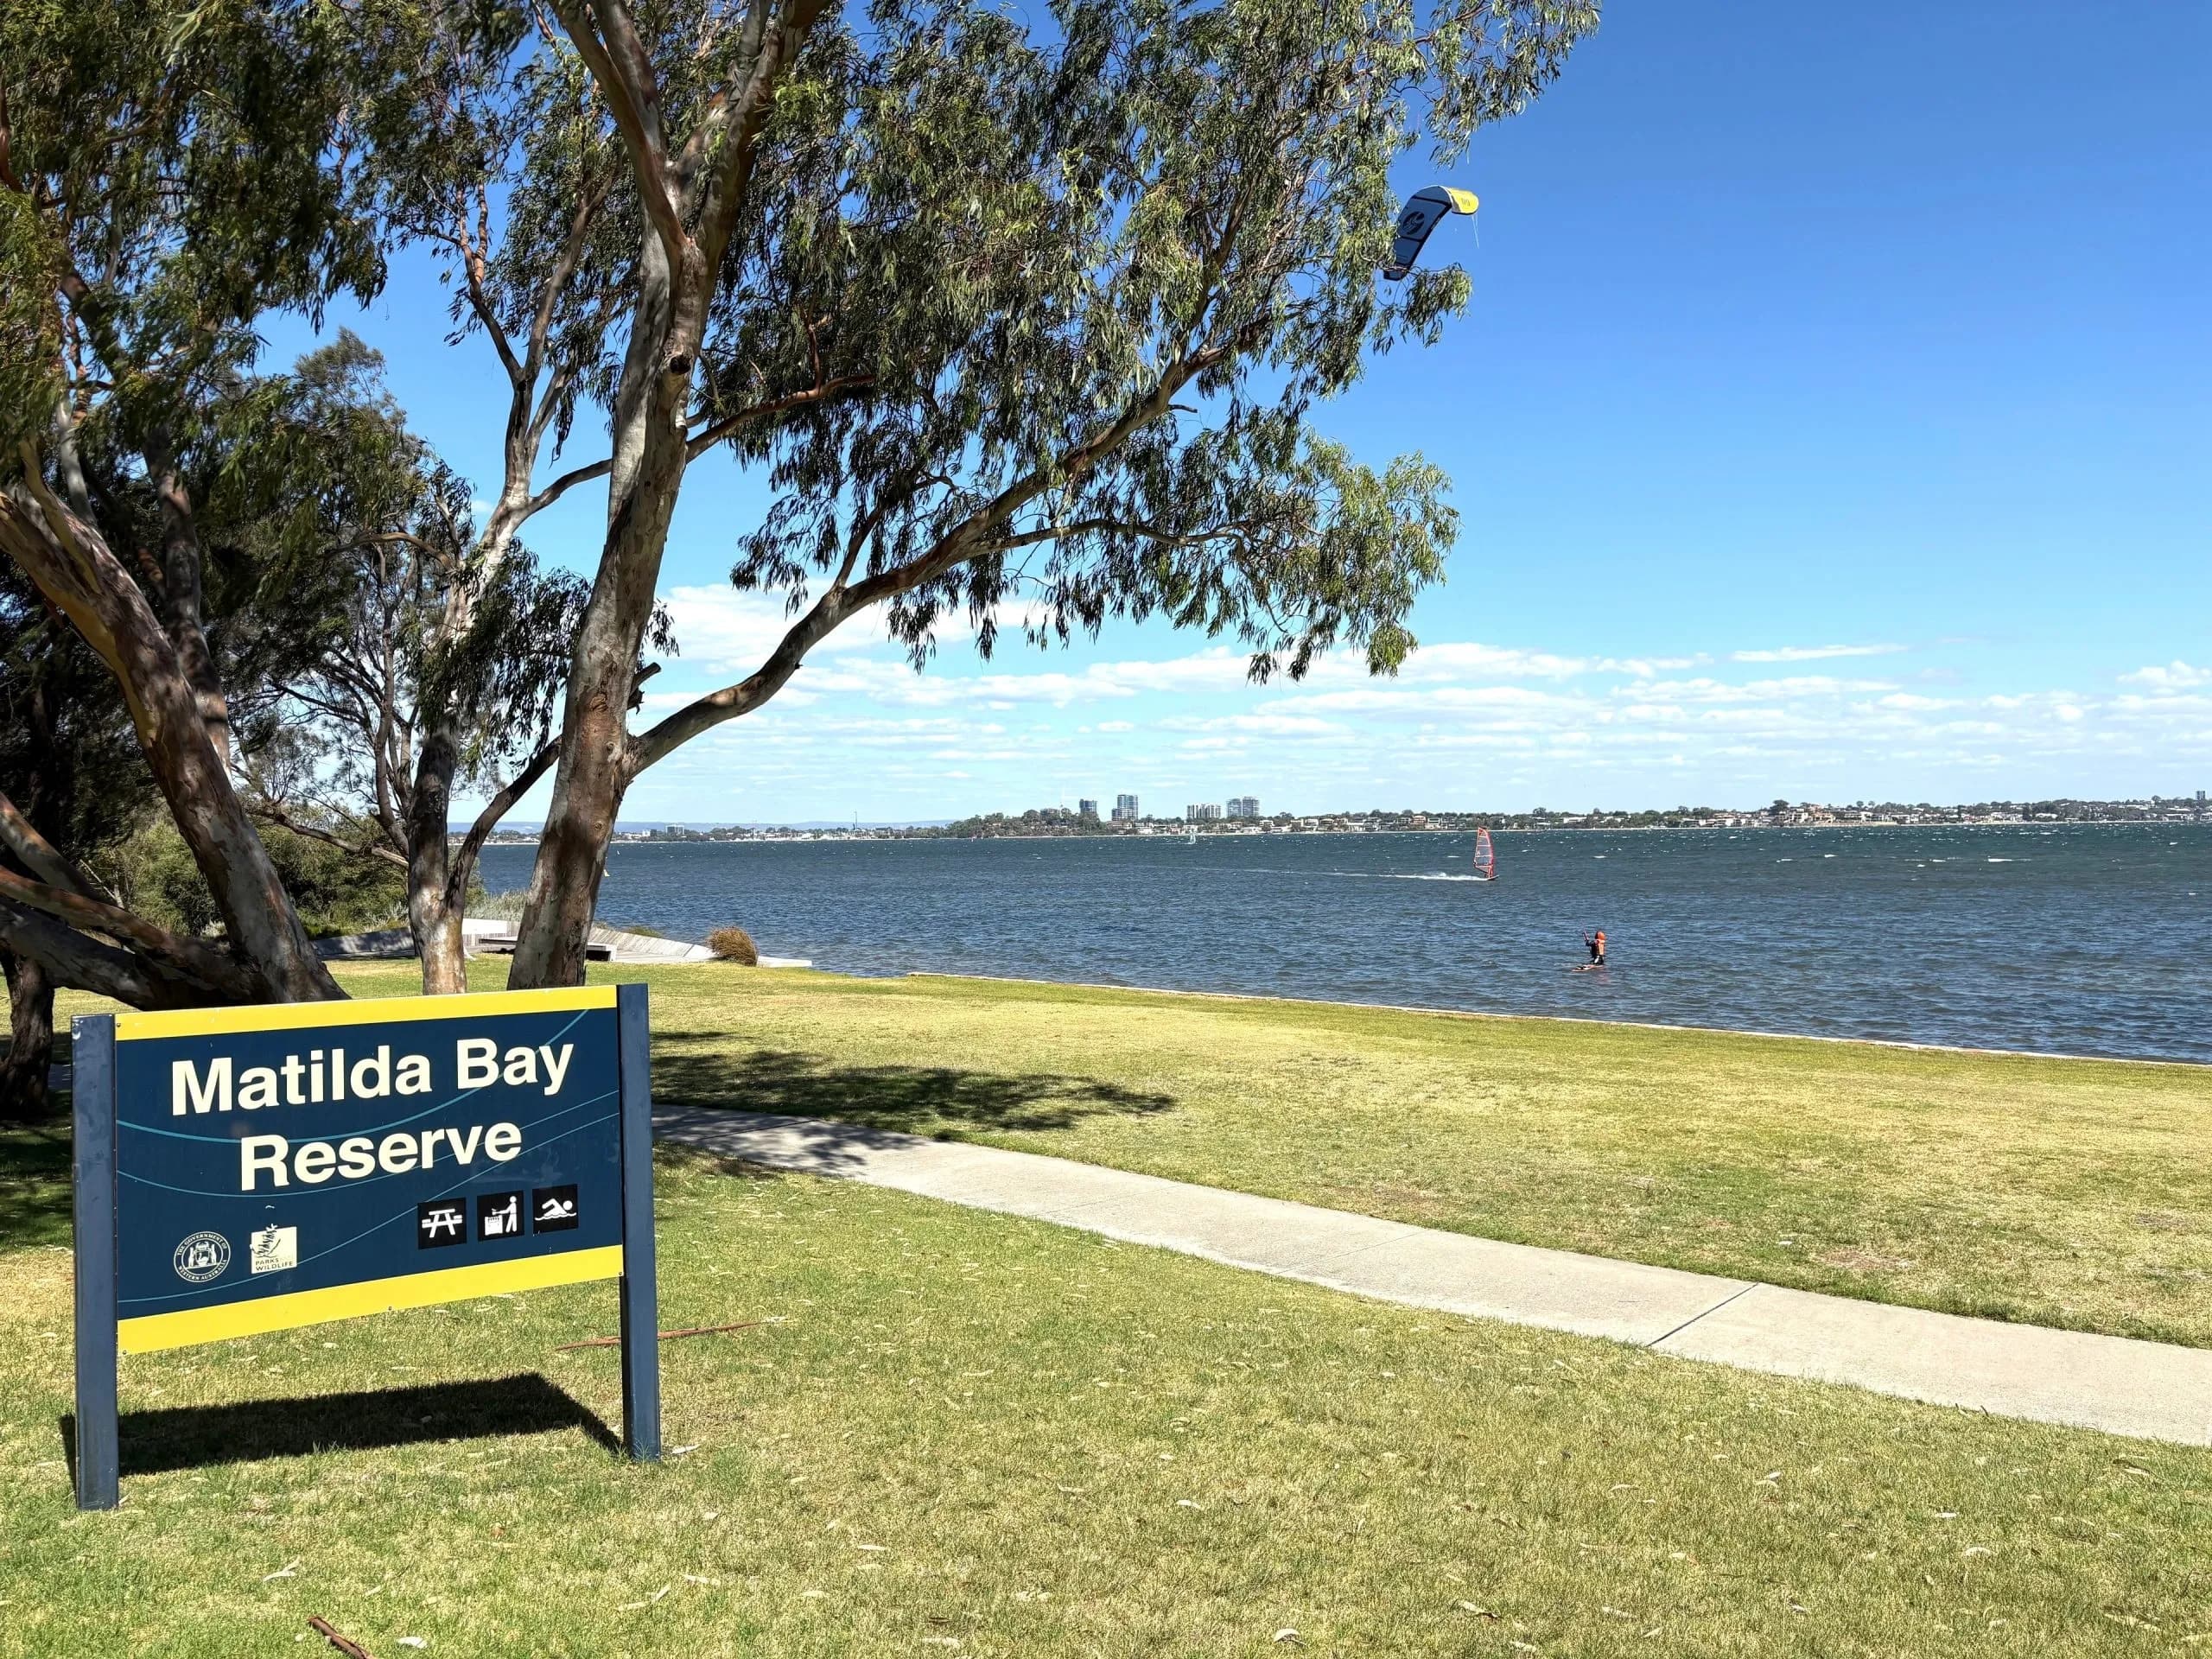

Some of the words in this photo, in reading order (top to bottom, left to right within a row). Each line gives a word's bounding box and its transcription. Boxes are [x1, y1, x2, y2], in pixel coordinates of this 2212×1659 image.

[173, 1045, 432, 1116] Matilda
[457, 1039, 574, 1095] Bay
[241, 1122, 522, 1192] Reserve
[184, 1234, 222, 1245] GOVERNMENT
[178, 1266, 200, 1280] WESTERN
[200, 1259, 228, 1280] AUSTRALIA
[255, 1262, 294, 1271] WILDLIFE
